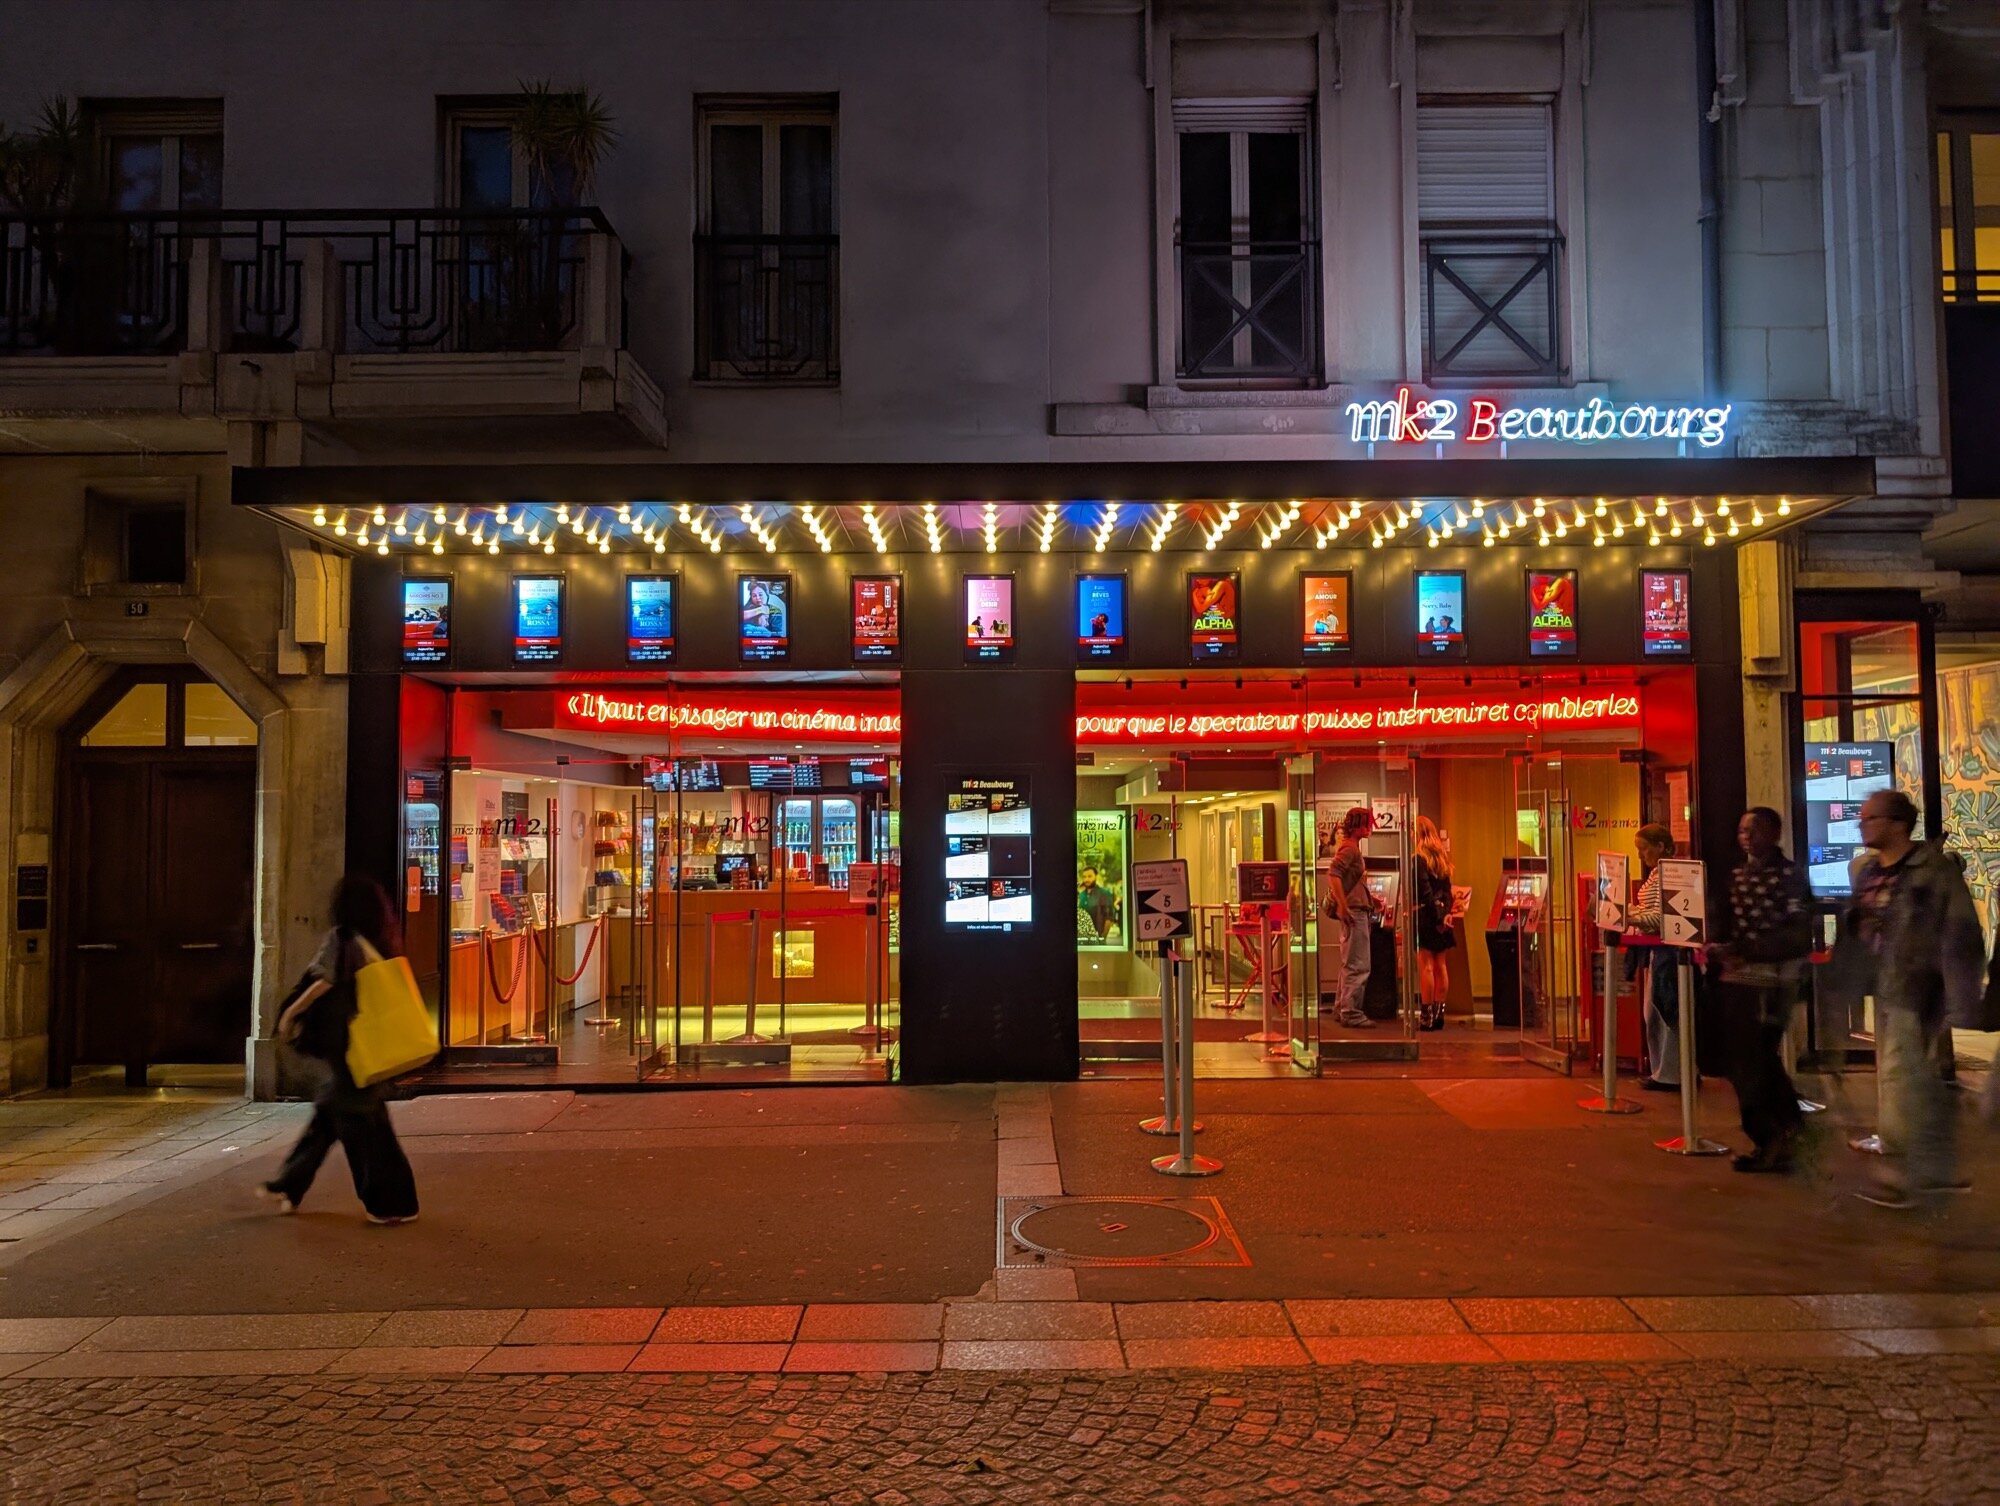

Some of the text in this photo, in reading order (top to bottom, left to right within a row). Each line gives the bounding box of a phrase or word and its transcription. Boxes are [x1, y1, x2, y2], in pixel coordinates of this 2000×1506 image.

[1345, 388, 1732, 447] mk2 Beaubourg
[131, 603, 143, 614] 50
[1194, 619, 1234, 630] ALPHA
[1532, 616, 1573, 627] ALPHA
[597, 694, 646, 723] faut
[647, 703, 747, 731] envisager
[749, 711, 779, 728] un
[780, 708, 856, 732] cinéma
[1076, 689, 1638, 737] pour que le spectateur puisse intervenir et combler les
[1838, 747, 1872, 756] Beaubourg
[979, 780, 1014, 789] Beaubourg
[454, 825, 474, 835] mk2
[495, 812, 541, 836] mk2
[724, 810, 769, 834] mk2
[1077, 820, 1096, 831] mk2
[1097, 820, 1117, 831] mk2
[1117, 808, 1162, 832] mk2
[1619, 818, 1638, 828] mk2
[1262, 876, 1270, 891] 5
[1613, 887, 1617, 898] 1
[1163, 895, 1171, 907] 5
[1683, 898, 1690, 911] 2
[1144, 919, 1151, 930] 6
[1164, 918, 1171, 928] B
[1674, 922, 1681, 935] 3
